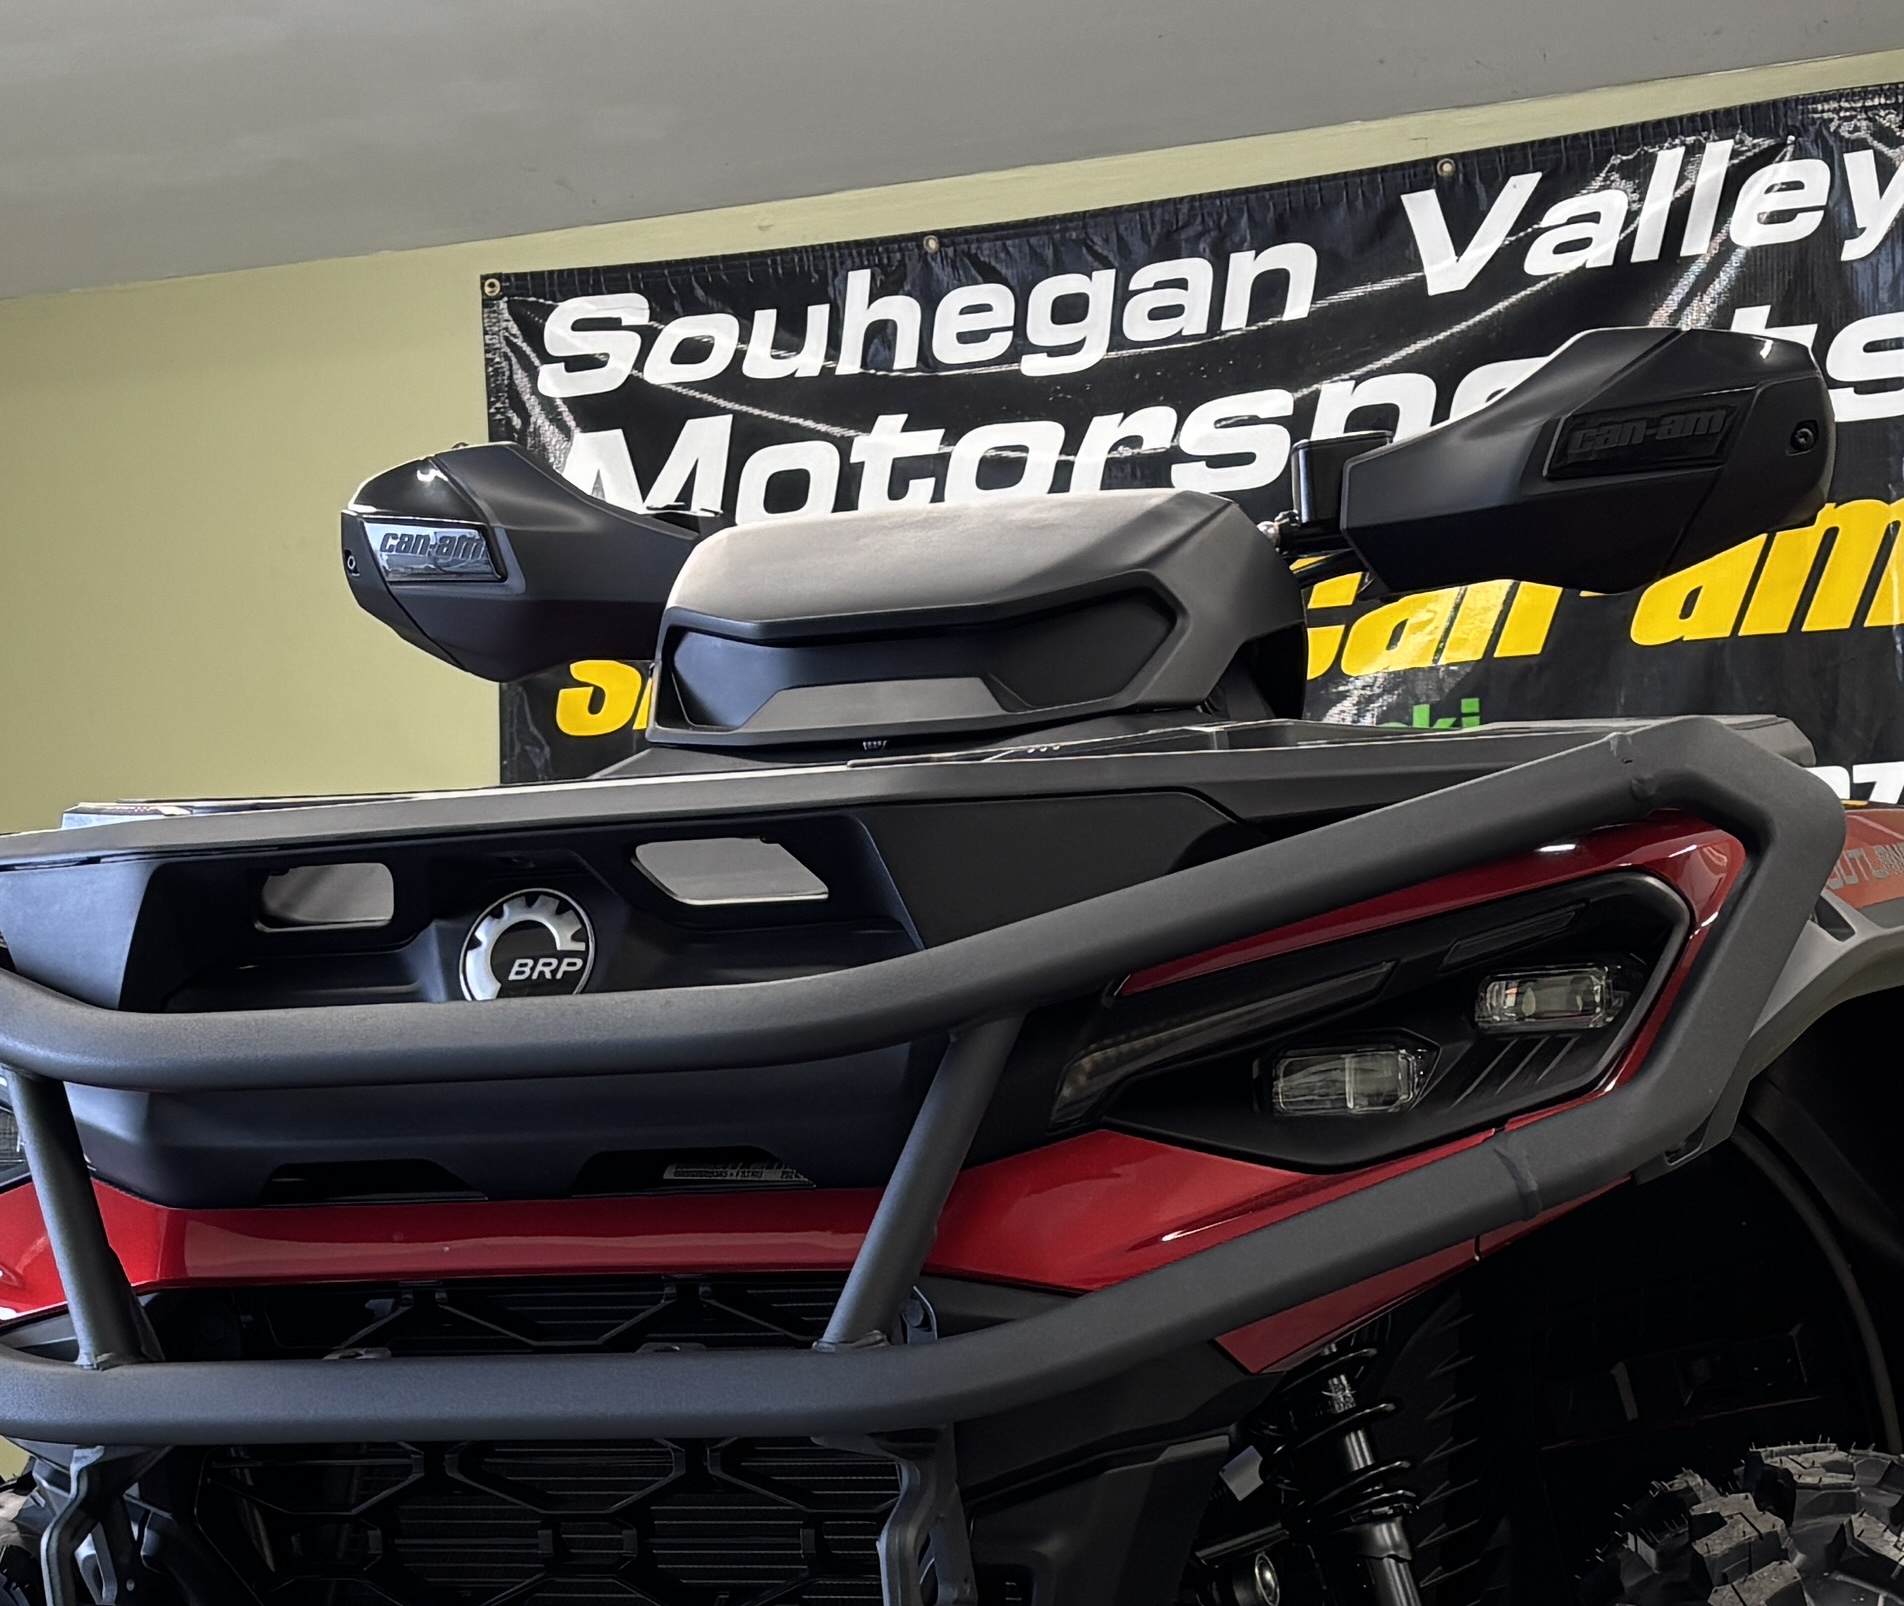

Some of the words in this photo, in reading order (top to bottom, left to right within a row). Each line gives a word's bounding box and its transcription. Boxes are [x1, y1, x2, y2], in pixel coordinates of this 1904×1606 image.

[537, 242, 1318, 397] Souhegan
[1567, 409, 1727, 457] can-am
[380, 532, 485, 560] can-am
[508, 957, 584, 981] BRP
